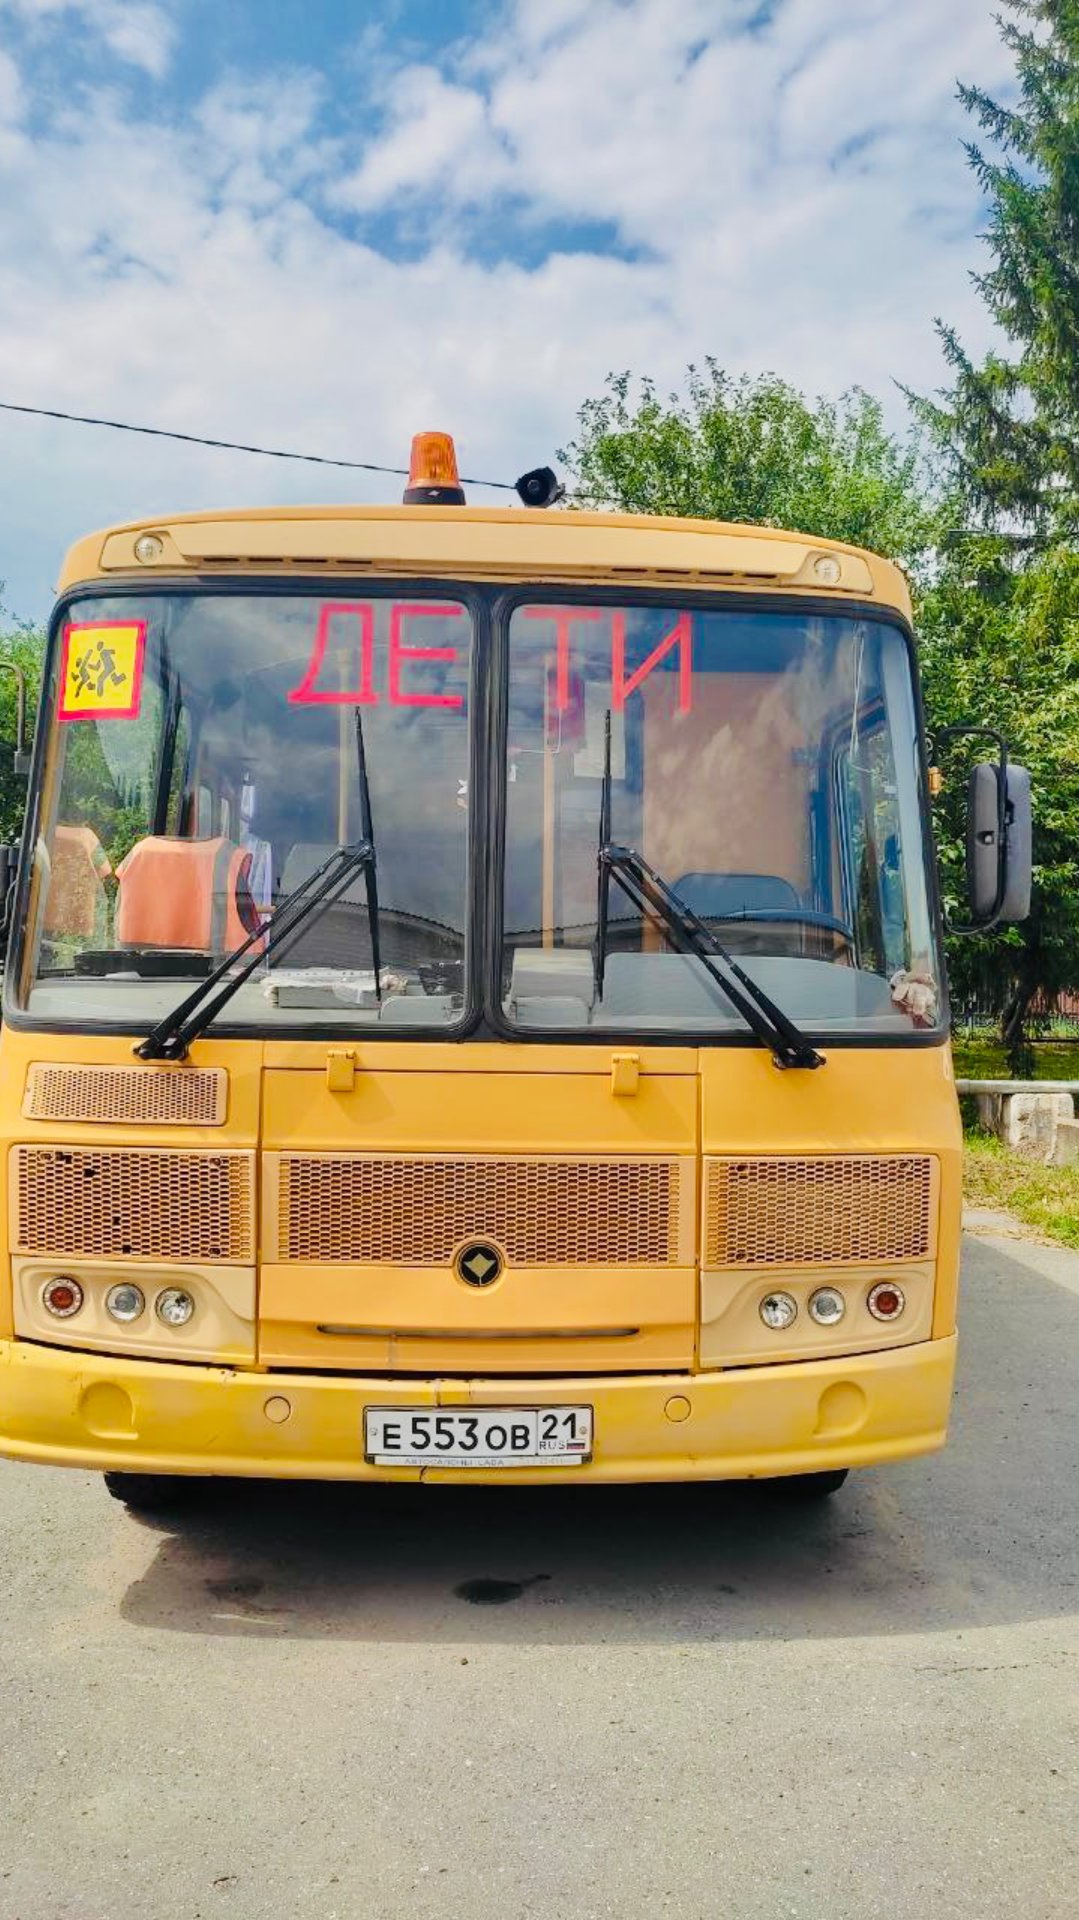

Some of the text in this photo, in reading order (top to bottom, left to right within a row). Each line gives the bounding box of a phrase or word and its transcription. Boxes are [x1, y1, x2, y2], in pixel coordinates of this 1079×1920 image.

[287, 603, 692, 715] ДЕТИ
[542, 1412, 577, 1440] 21
[539, 1441, 566, 1450] RUS
